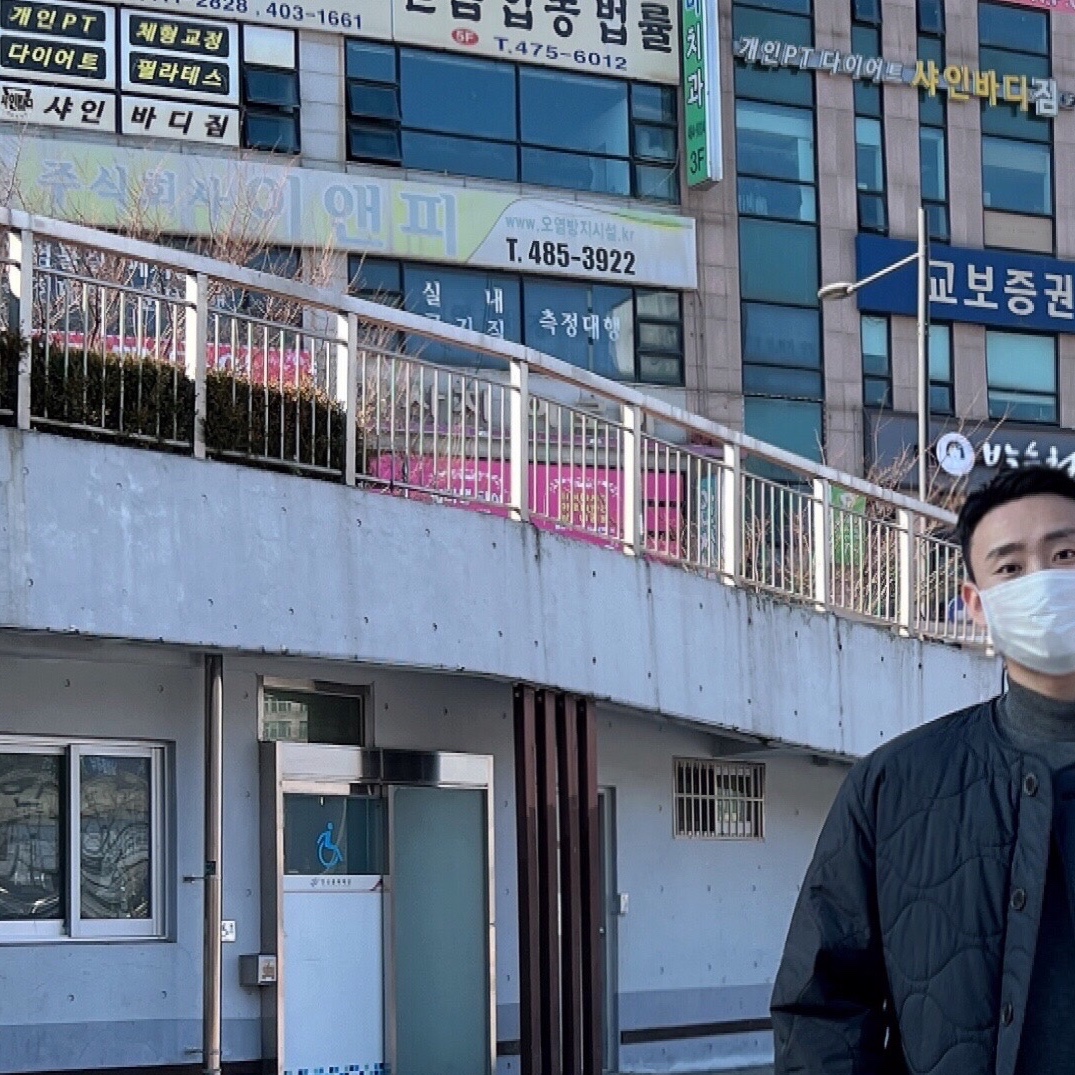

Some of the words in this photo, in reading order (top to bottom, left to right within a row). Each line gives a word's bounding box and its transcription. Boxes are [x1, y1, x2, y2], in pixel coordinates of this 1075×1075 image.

[265, 3, 362, 29] 403-1661
[136, 22, 224, 50] 체형교정
[8, 43, 99, 71] 다이어트
[493, 36, 627, 71] T.475-6012
[685, 22, 705, 110] 치과
[136, 58, 225, 87] 필라테스
[819, 50, 904, 83] 다이어트
[911, 58, 1058, 118] 샤인바디짐
[44, 95, 106, 125] 샤인
[131, 106, 229, 138] 바디짐
[688, 148, 706, 174] 3F
[538, 307, 623, 343] 측정대행
